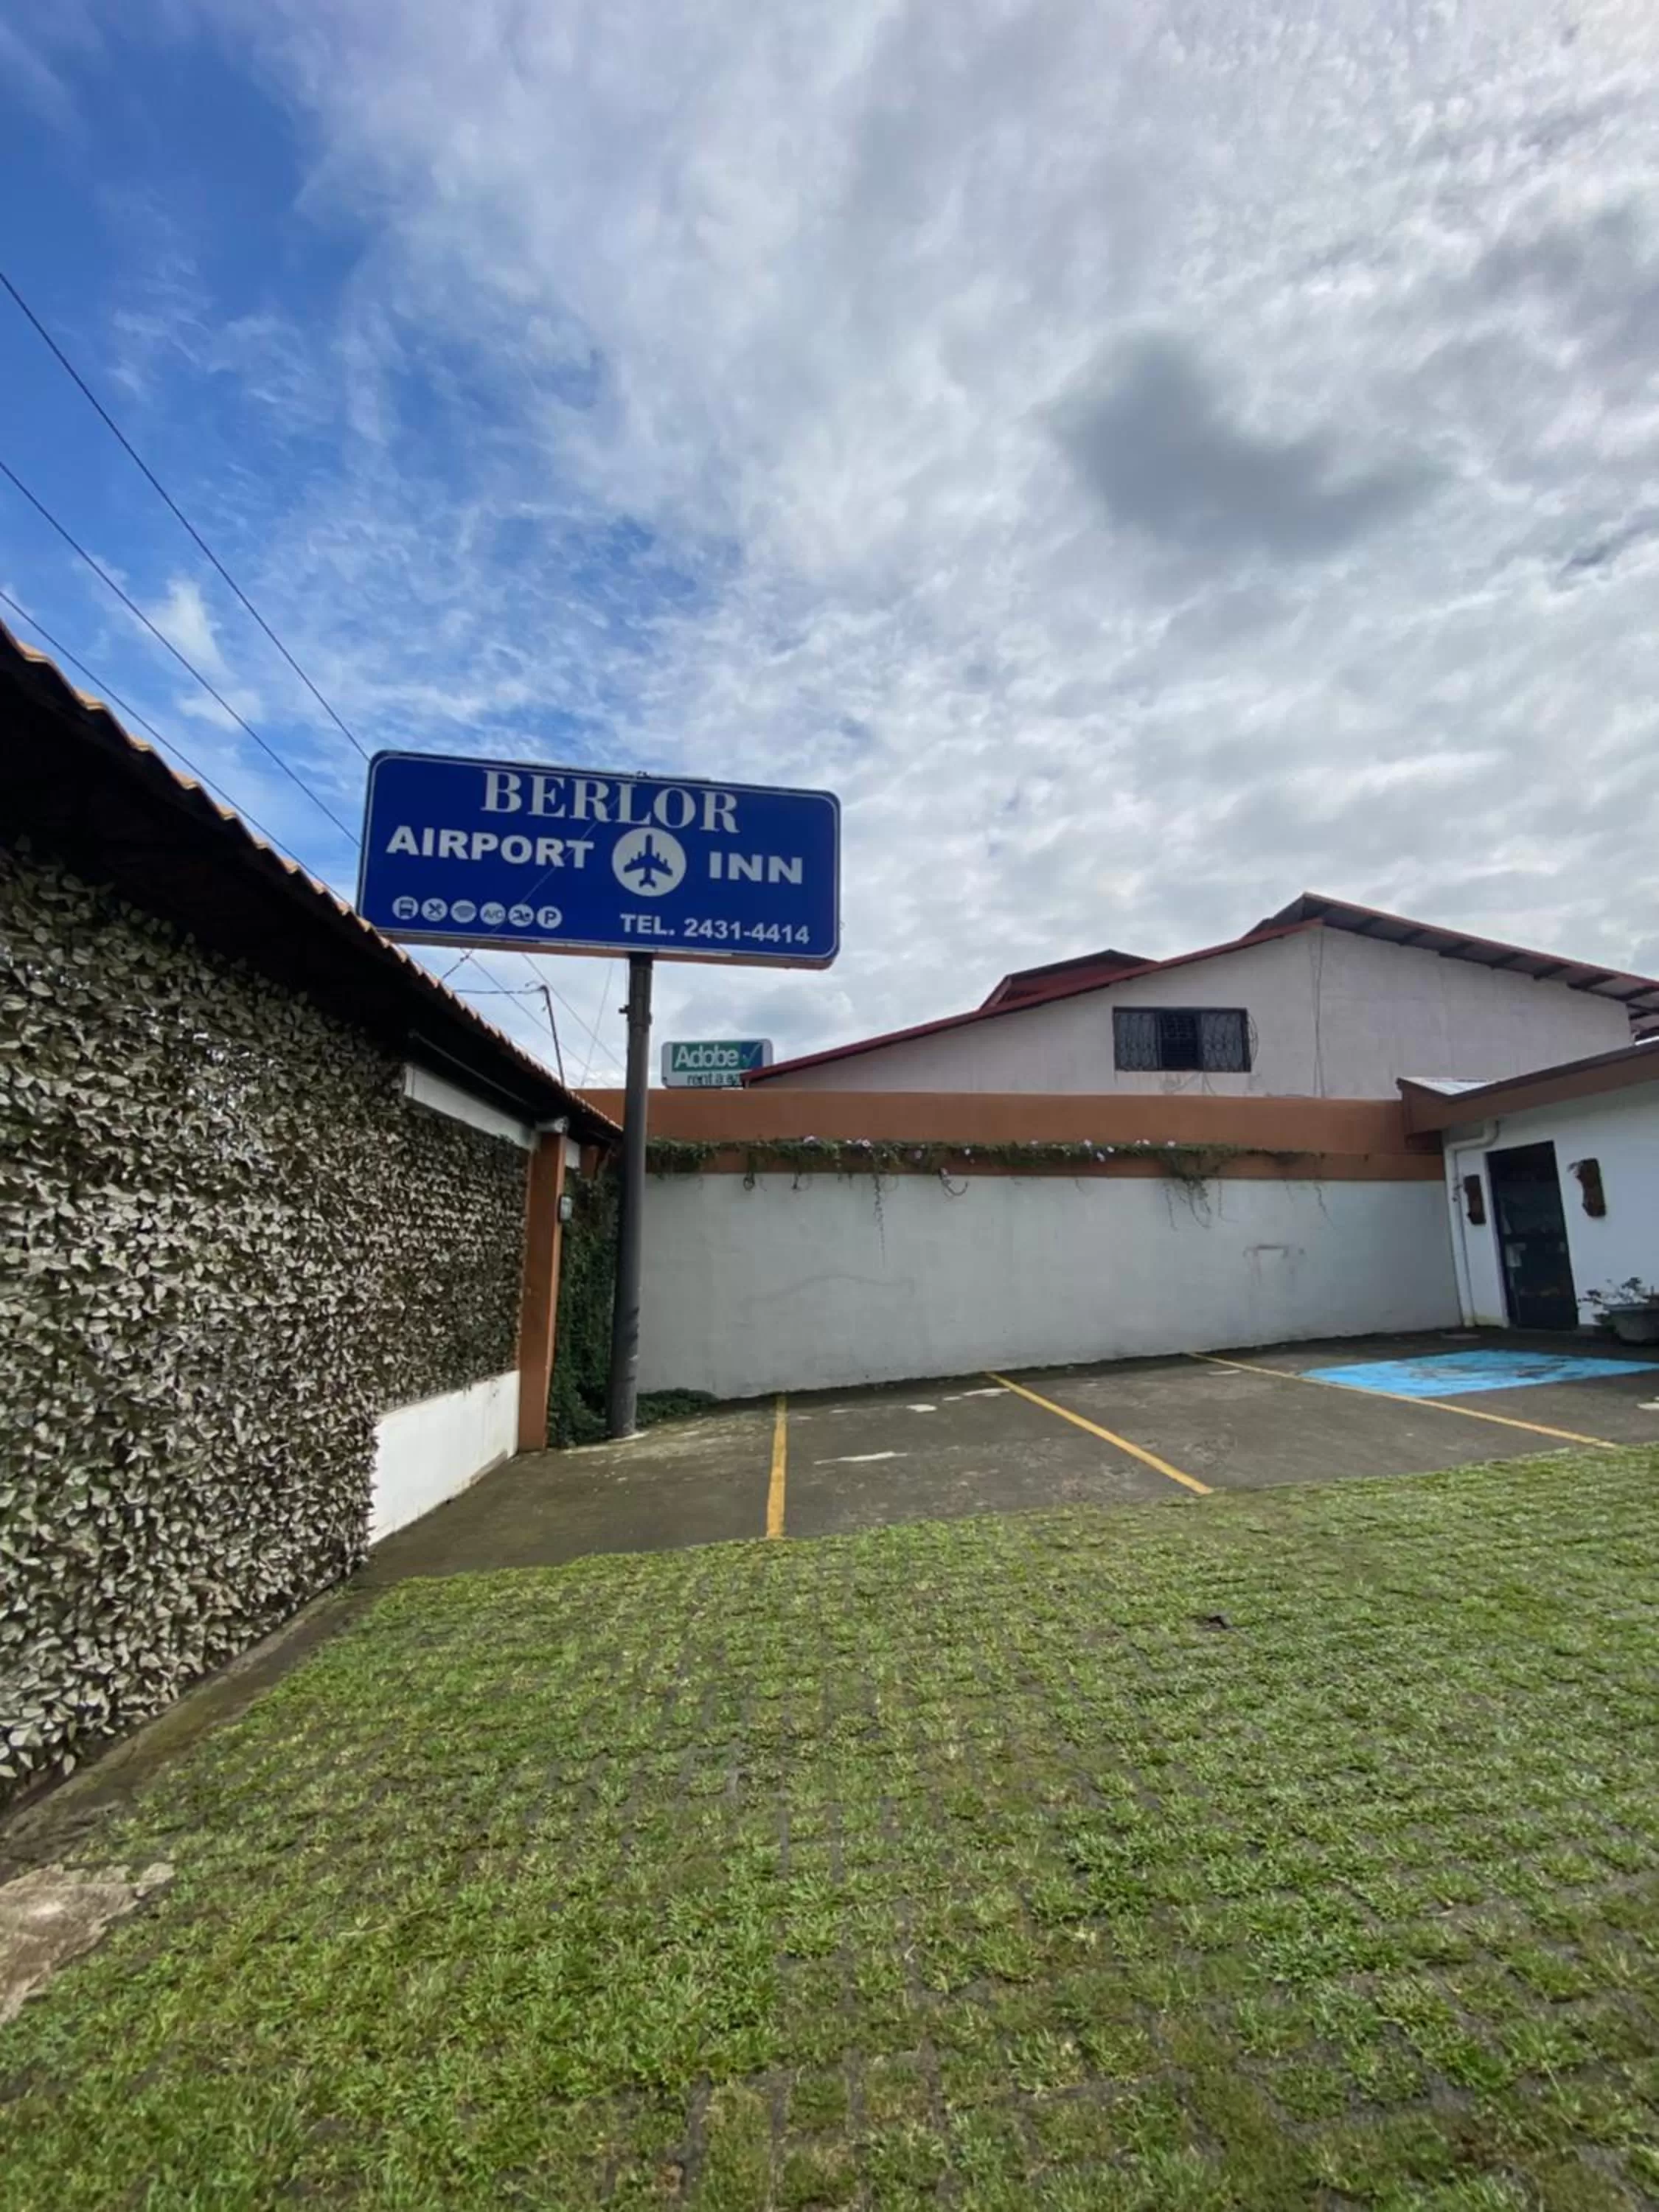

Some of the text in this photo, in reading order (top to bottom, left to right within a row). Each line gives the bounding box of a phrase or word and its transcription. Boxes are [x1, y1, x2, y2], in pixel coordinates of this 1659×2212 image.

[481, 770, 740, 833] BERLOR
[386, 825, 803, 884] AIRPORT INN
[544, 911, 557, 925] P
[620, 913, 810, 945] TEL. 2431-4414
[674, 1044, 740, 1068] Adobe
